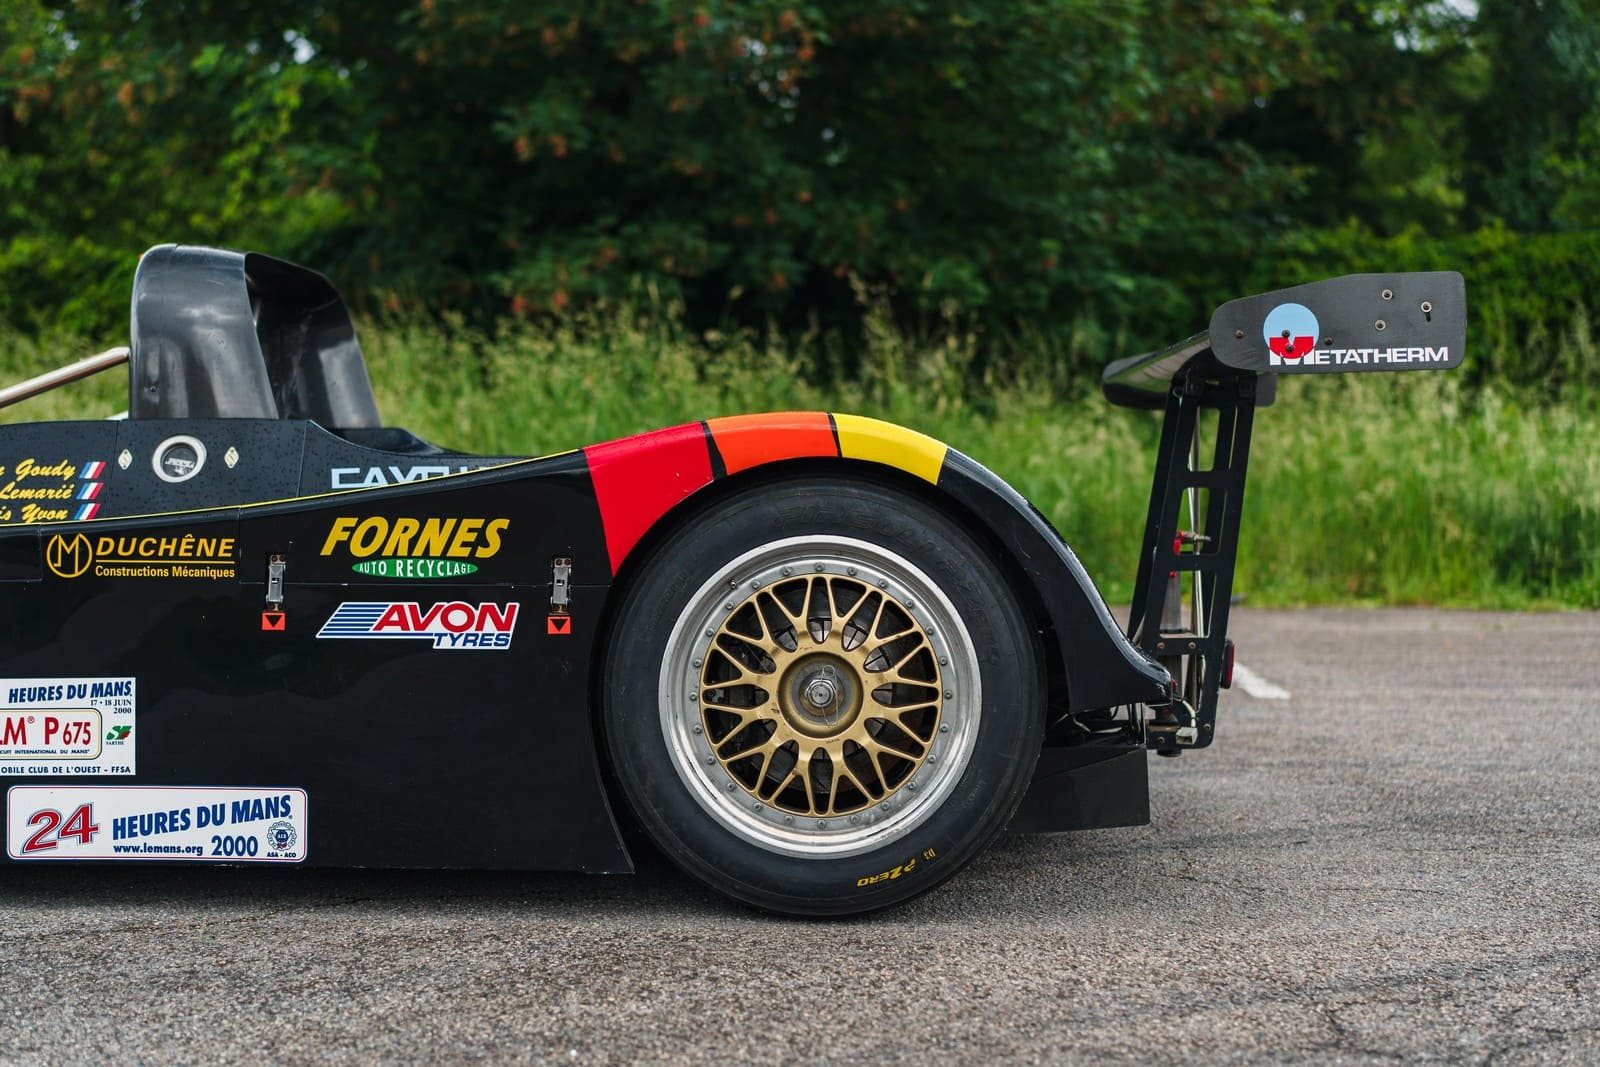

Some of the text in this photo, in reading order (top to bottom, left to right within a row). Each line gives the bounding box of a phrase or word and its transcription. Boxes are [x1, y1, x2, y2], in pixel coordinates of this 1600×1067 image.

[1269, 336, 1448, 366] METATHERM
[15, 458, 76, 481] Goudy
[0, 481, 75, 499] Lemarié
[21, 503, 68, 524] Yvon
[96, 533, 235, 557] DUCHÊNE
[319, 516, 510, 558] FORNES
[95, 565, 235, 580] Constructions Mécaniques
[359, 559, 472, 578] AUTO RECYCLAGE
[371, 602, 518, 632] AVON
[434, 632, 511, 647] TYRES
[8, 681, 132, 703] HEURES DU MANS
[28, 766, 49, 774] CLUB
[52, 766, 63, 774] DE
[66, 766, 101, 774] L'OUEST
[111, 766, 131, 774] FFSA
[20, 795, 291, 855] 24 HEURES DU MANS
[113, 834, 259, 857] www.lemans.org 2000
